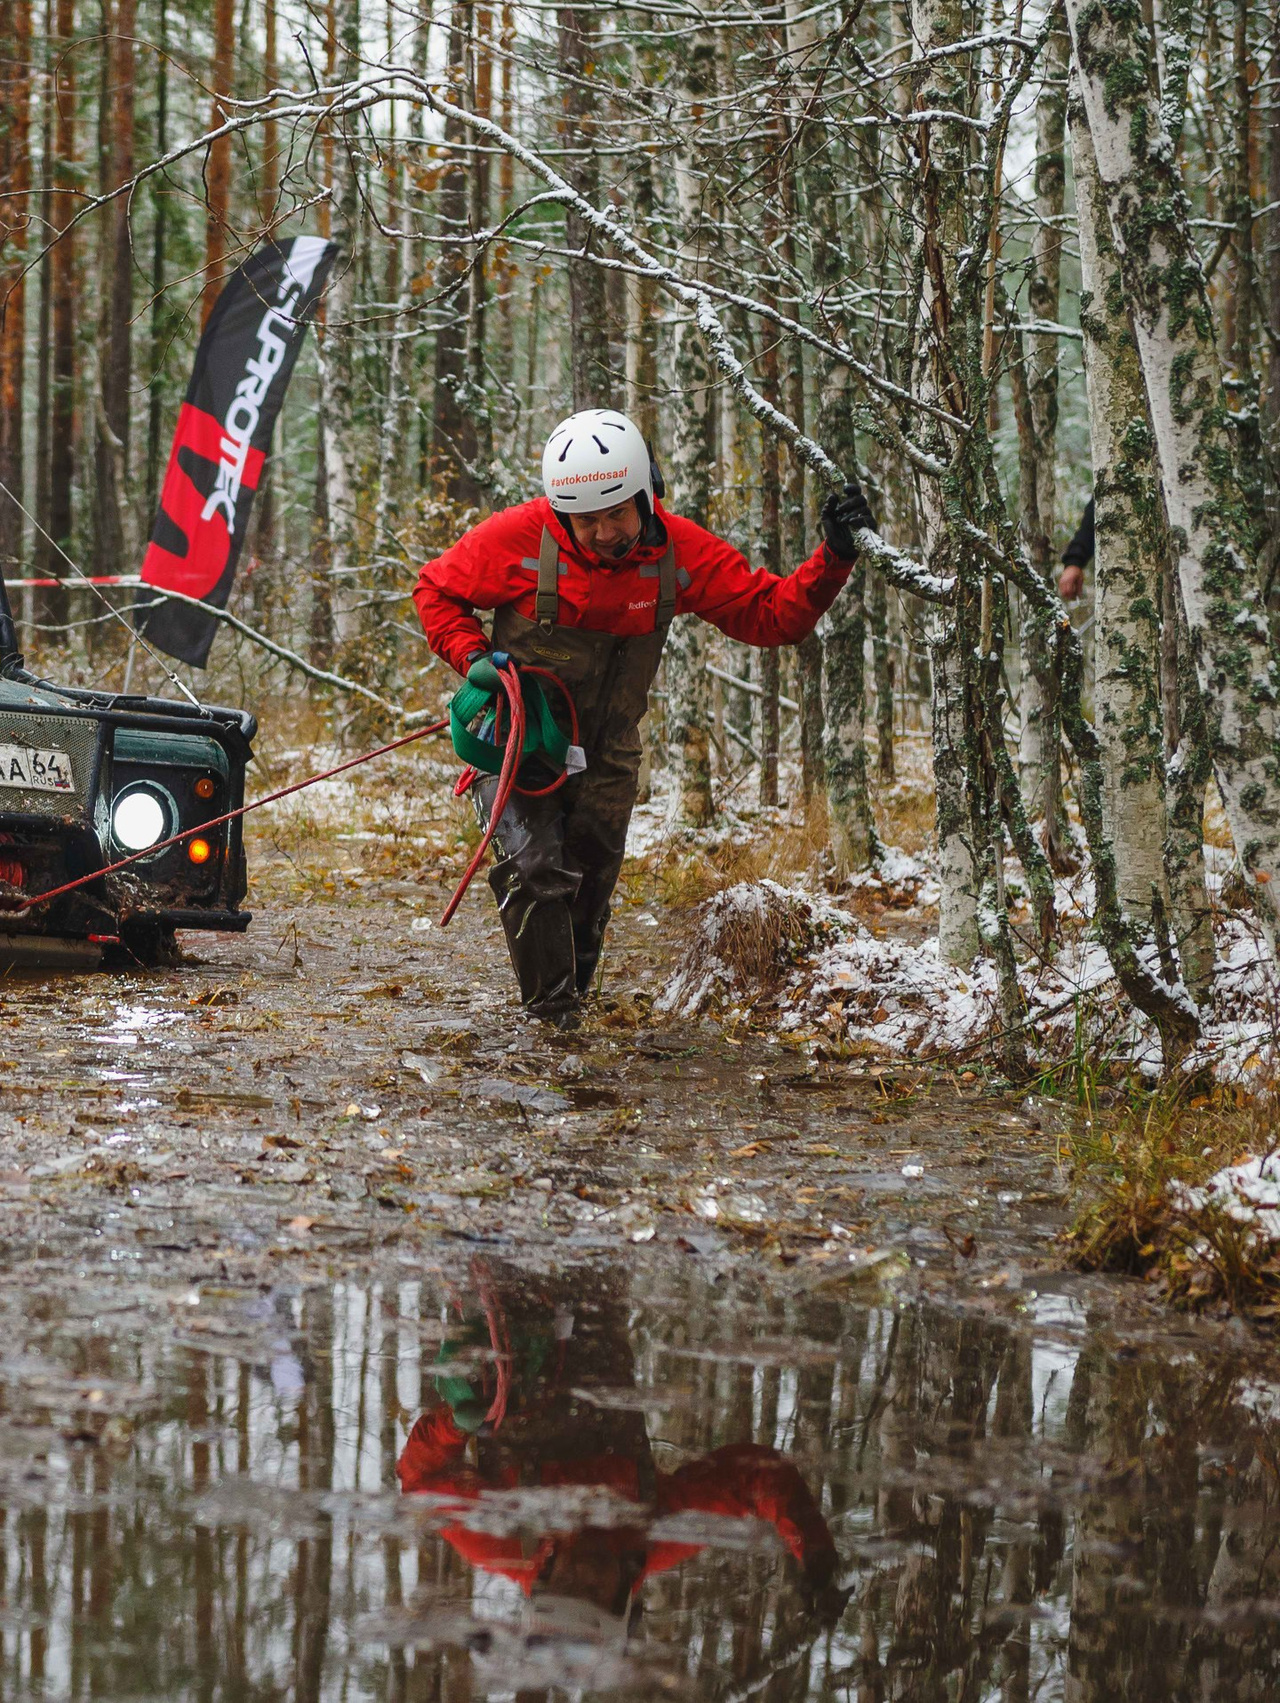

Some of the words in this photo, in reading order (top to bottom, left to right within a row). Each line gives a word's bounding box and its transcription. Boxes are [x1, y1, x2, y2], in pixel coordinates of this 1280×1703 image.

[200, 248, 318, 535] SUPROTEC
[551, 467, 628, 487] #avtokotdosaaf
[33, 753, 63, 779] 64
[33, 775, 54, 786] RUS
